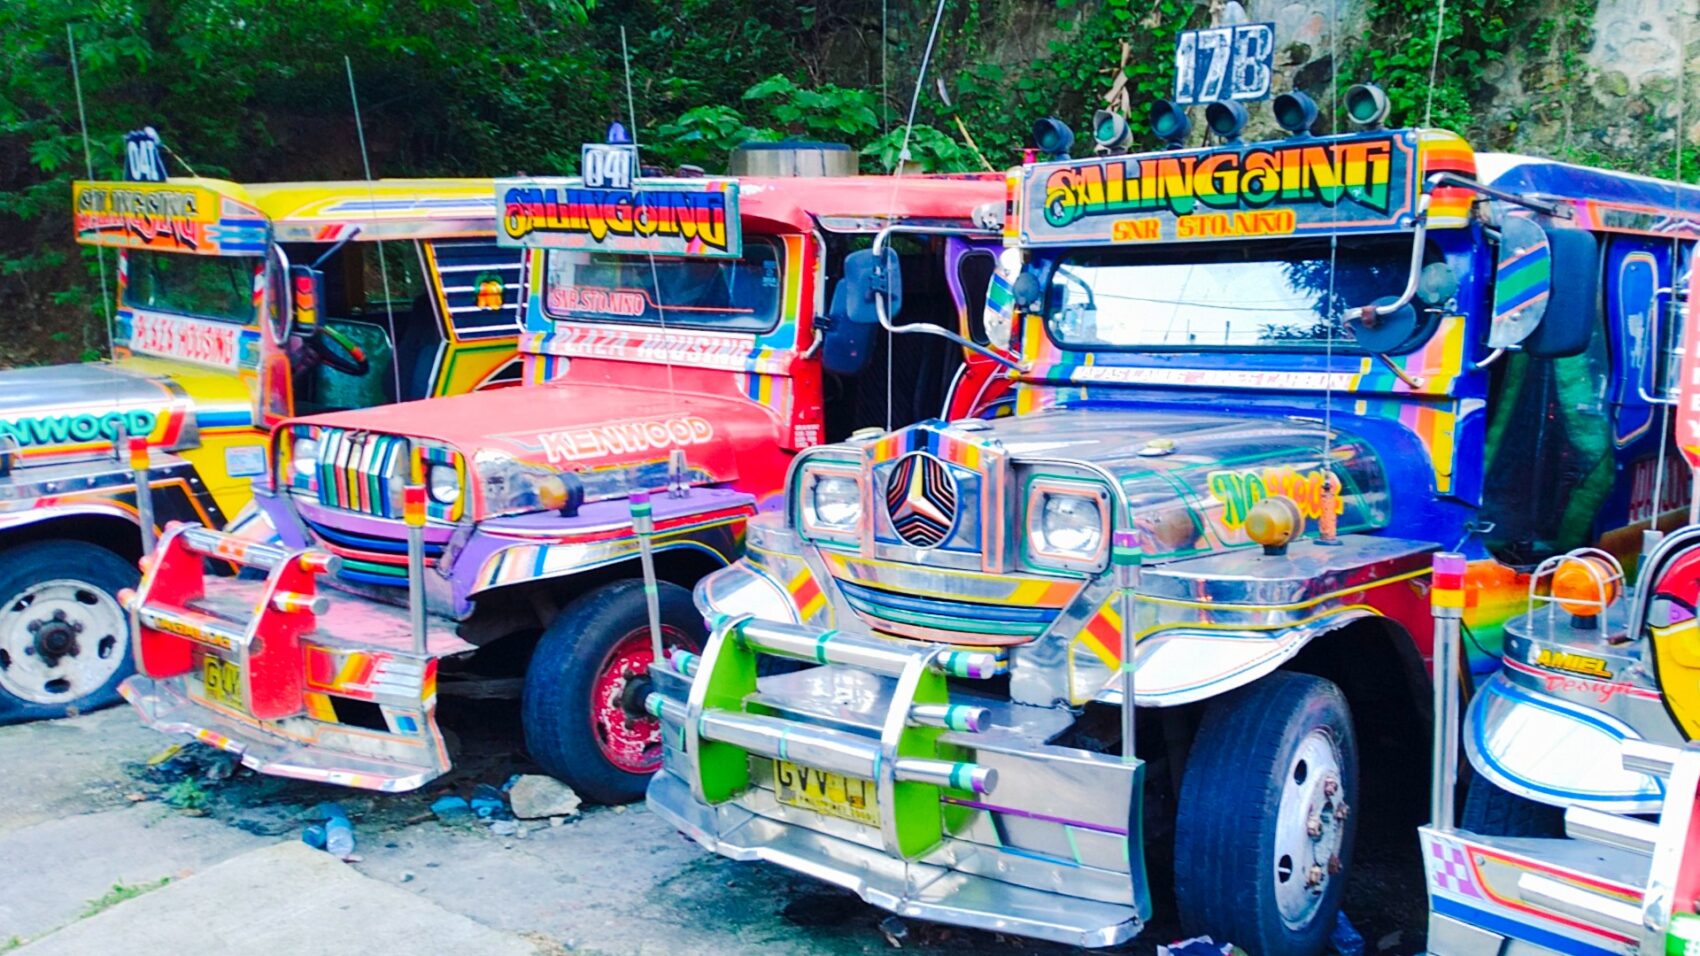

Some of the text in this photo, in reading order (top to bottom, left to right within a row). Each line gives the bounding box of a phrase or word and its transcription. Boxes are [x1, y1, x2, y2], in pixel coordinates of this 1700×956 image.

[1175, 24, 1274, 104] 17B
[1044, 139, 1392, 228] SALINGSING
[504, 188, 728, 251] SALINGSING
[539, 417, 714, 464] KENWOOD
[1536, 648, 1613, 680] AMIEL
